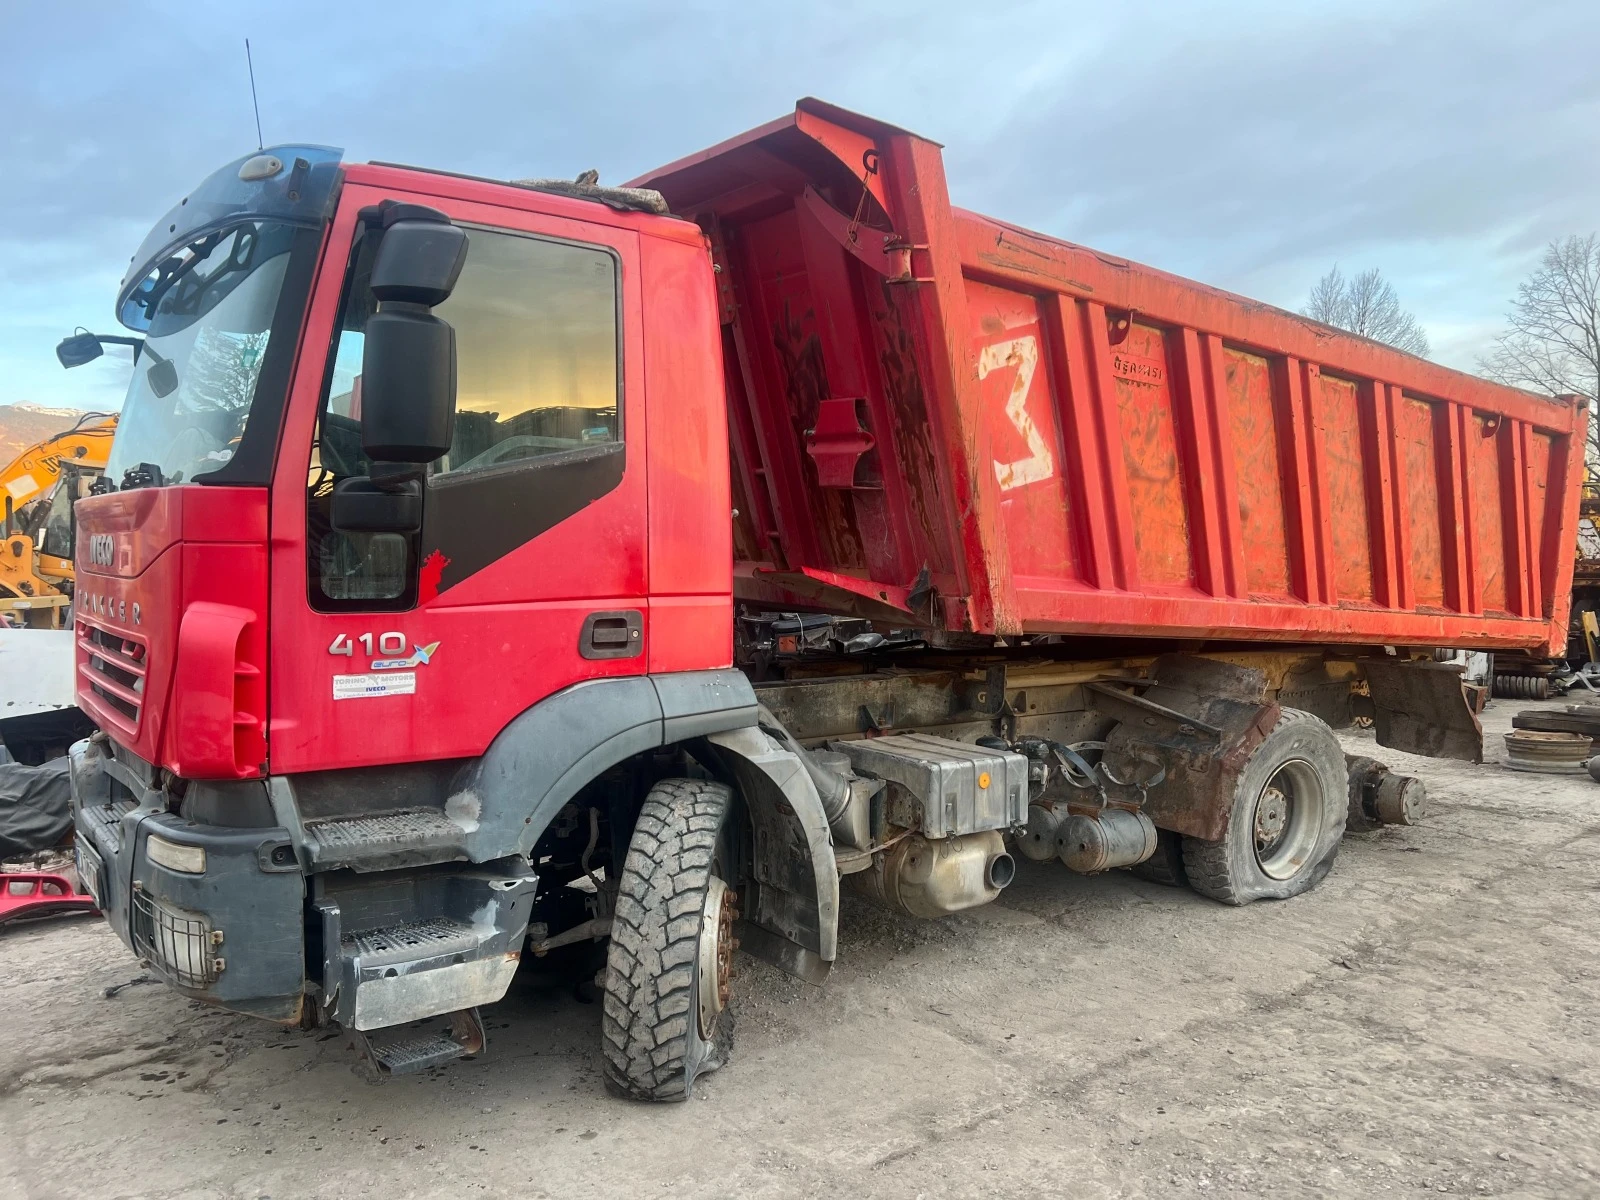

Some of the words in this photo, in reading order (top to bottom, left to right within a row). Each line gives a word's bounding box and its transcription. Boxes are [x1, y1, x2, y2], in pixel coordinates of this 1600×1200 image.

[978, 336, 1053, 491] 3
[41, 454, 62, 474] JC
[90, 535, 115, 567] IVECO
[78, 589, 141, 625] TRAKKER
[328, 631, 407, 657] 410
[335, 677, 366, 685] TORINO
[380, 674, 414, 682] MOTORS
